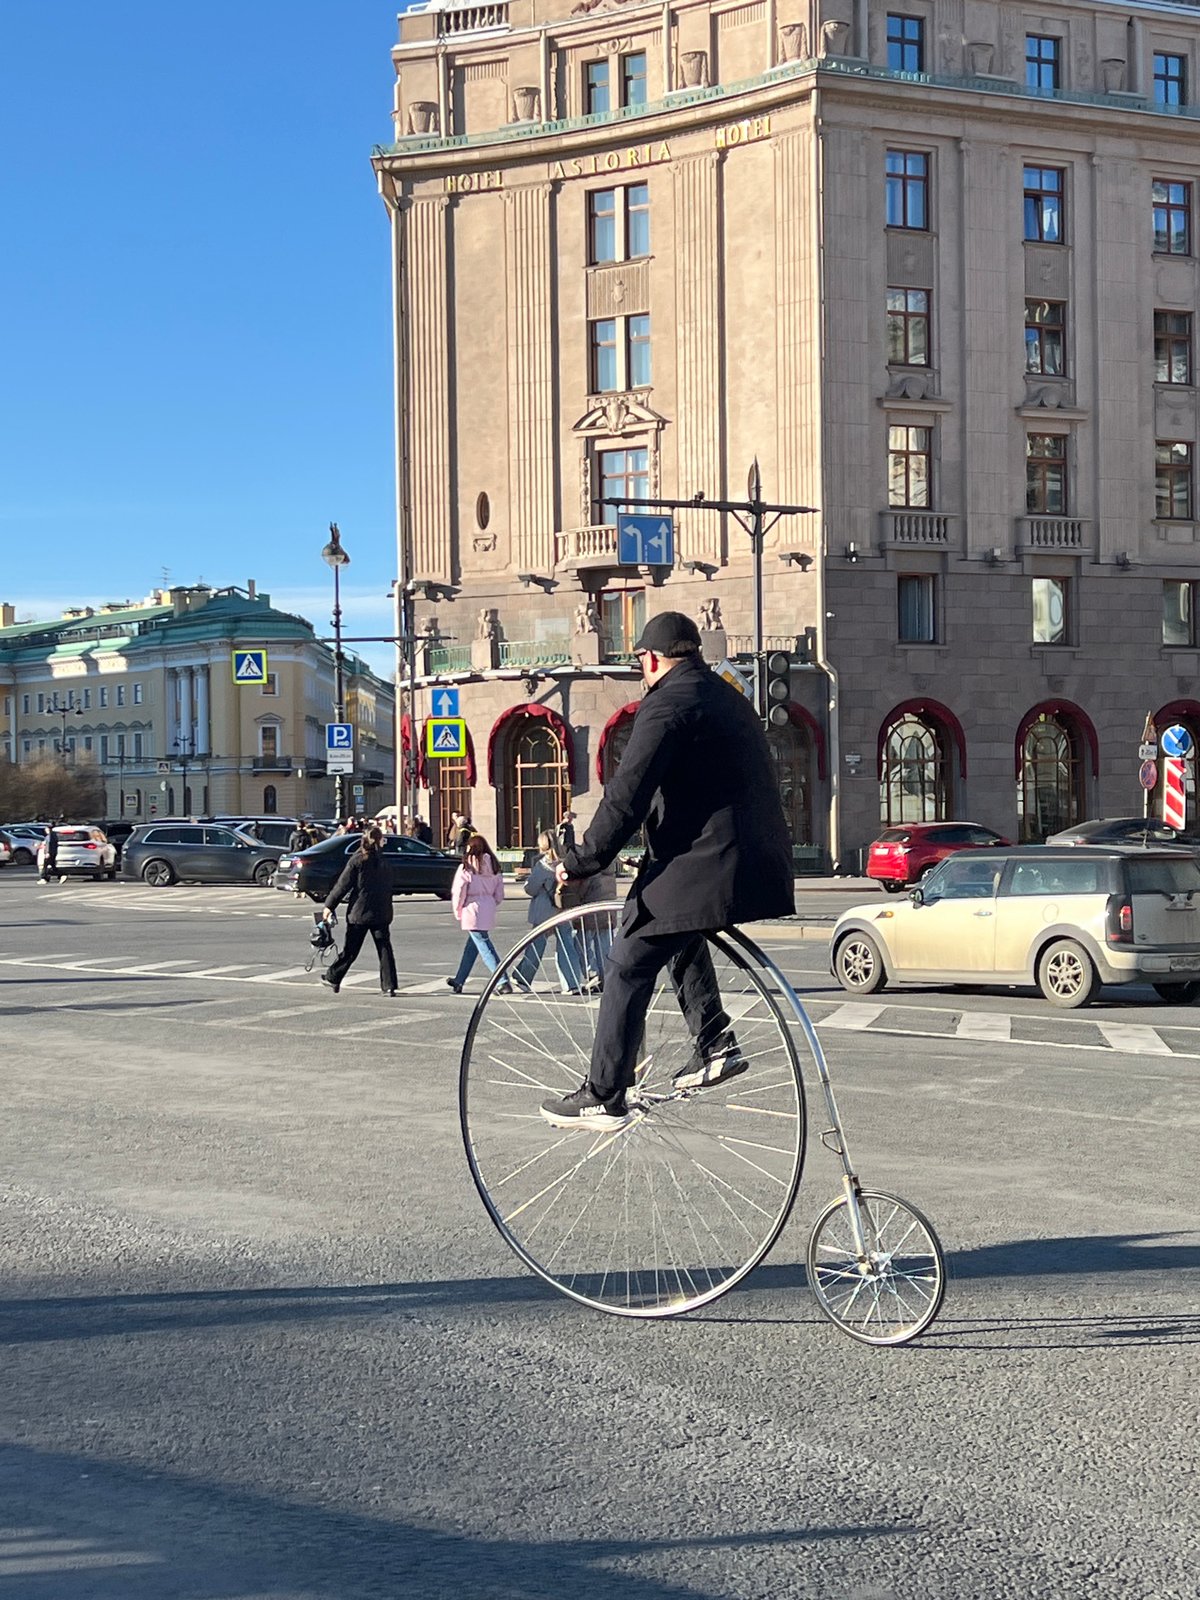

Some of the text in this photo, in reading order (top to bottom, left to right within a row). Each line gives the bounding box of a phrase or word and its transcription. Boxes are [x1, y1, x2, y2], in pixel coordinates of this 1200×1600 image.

[716, 116, 770, 147] HOTEL
[554, 140, 671, 179] ASTORIA
[446, 170, 504, 192] HOTEL
[580, 1104, 606, 1117] HOKA
